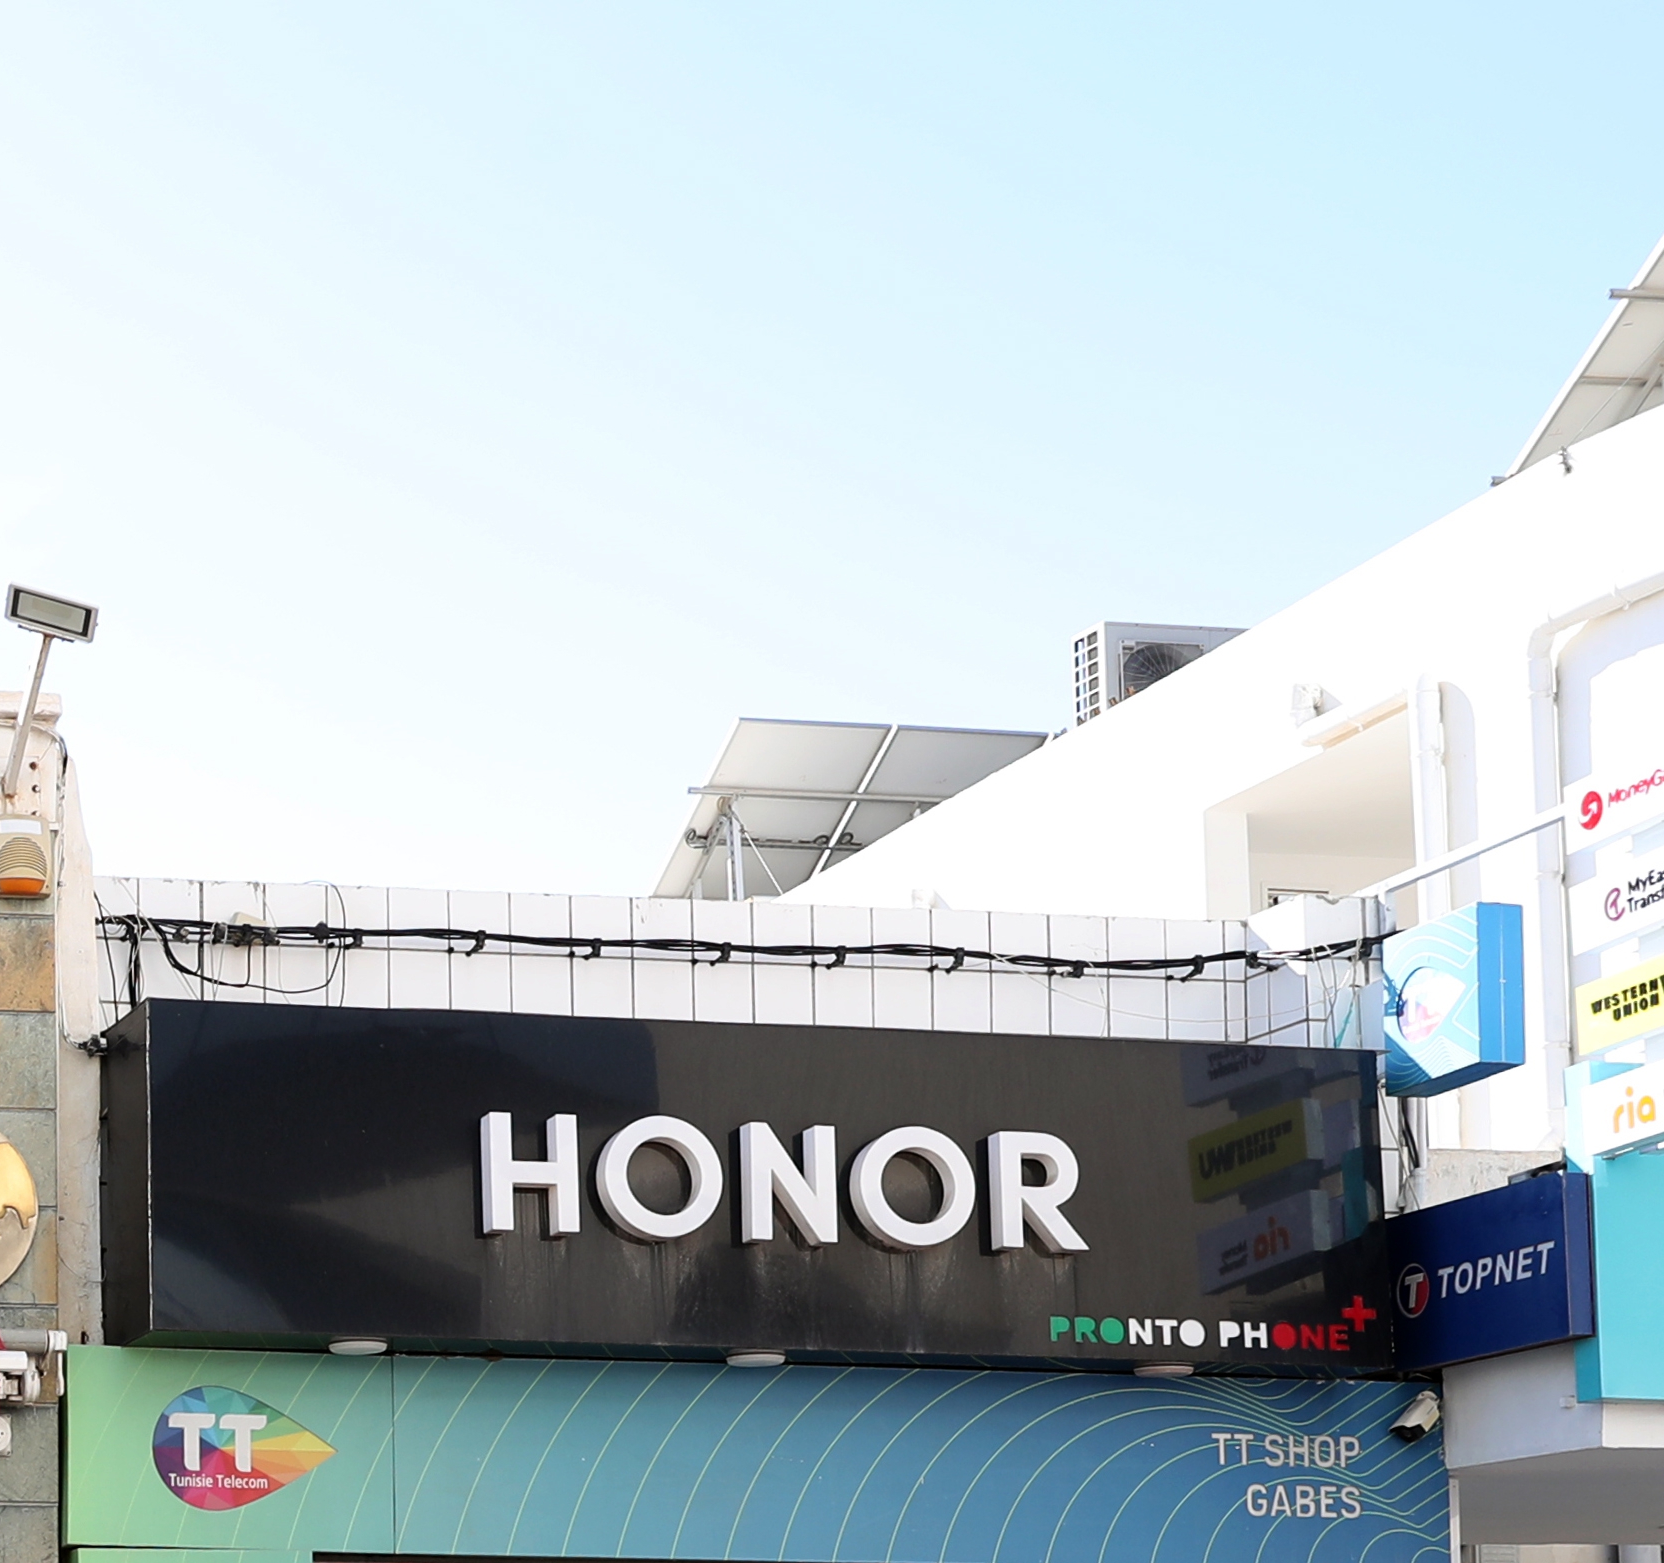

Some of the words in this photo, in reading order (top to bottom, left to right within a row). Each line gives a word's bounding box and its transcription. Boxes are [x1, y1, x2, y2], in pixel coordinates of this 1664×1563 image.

[1608, 769, 1664, 808] MoneyG
[1590, 978, 1659, 1015] WESTERN
[1613, 992, 1660, 1021] UNION
[1613, 1086, 1657, 1133] ria
[480, 1111, 1090, 1251] HONOR
[1438, 1240, 1555, 1299] TOPNET
[1050, 1316, 1206, 1347] PRONTO
[168, 1412, 268, 1473] TT
[1211, 1433, 1254, 1466] TT
[1264, 1434, 1361, 1468] SHOP
[168, 1473, 213, 1488] Tunisie
[216, 1474, 268, 1490] Telecom
[1246, 1483, 1362, 1519] GABES
